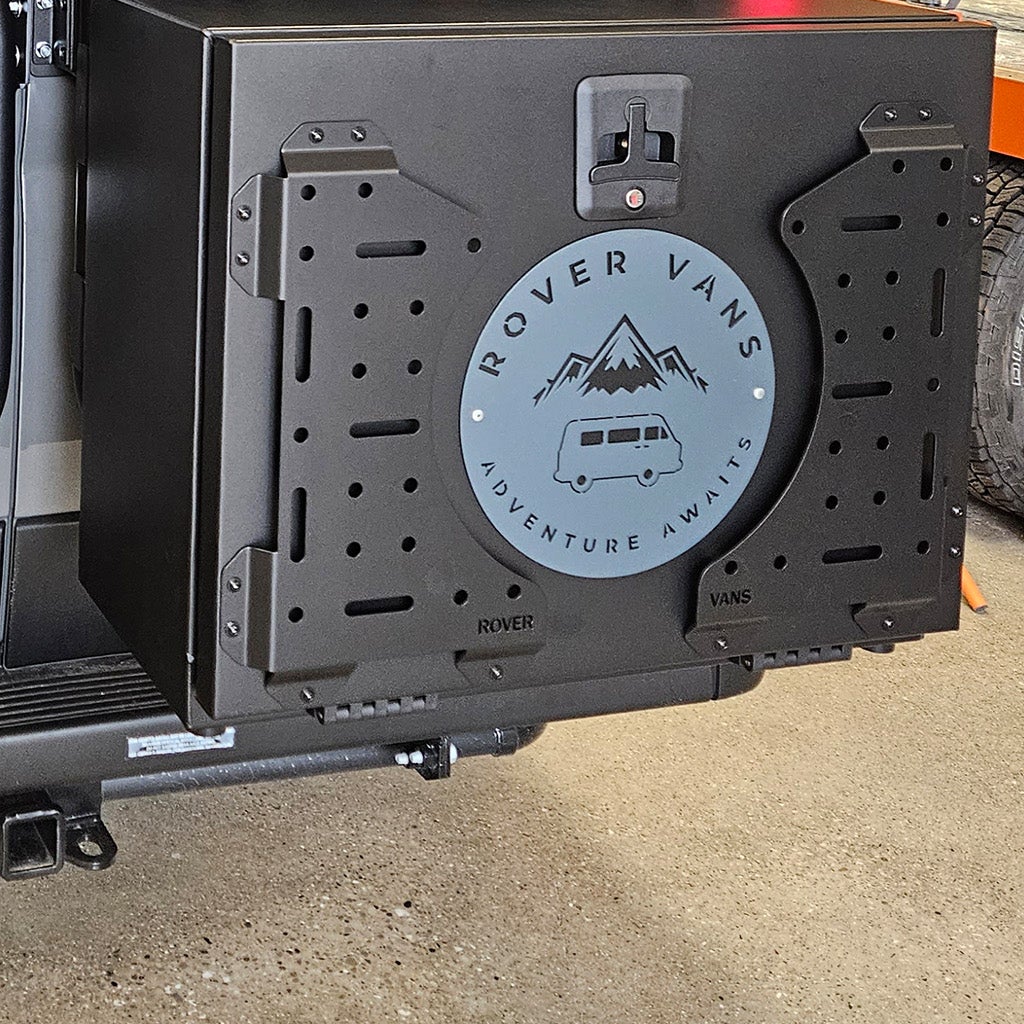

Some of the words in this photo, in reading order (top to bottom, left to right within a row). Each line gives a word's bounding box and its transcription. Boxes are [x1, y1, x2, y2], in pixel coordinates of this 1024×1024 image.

[478, 249, 627, 378] ROVER
[668, 252, 763, 359] VANS
[480, 460, 641, 554] ADVENTURE
[662, 436, 753, 539] AWAITS
[477, 614, 534, 635] ROVER
[709, 588, 752, 608] VANS
